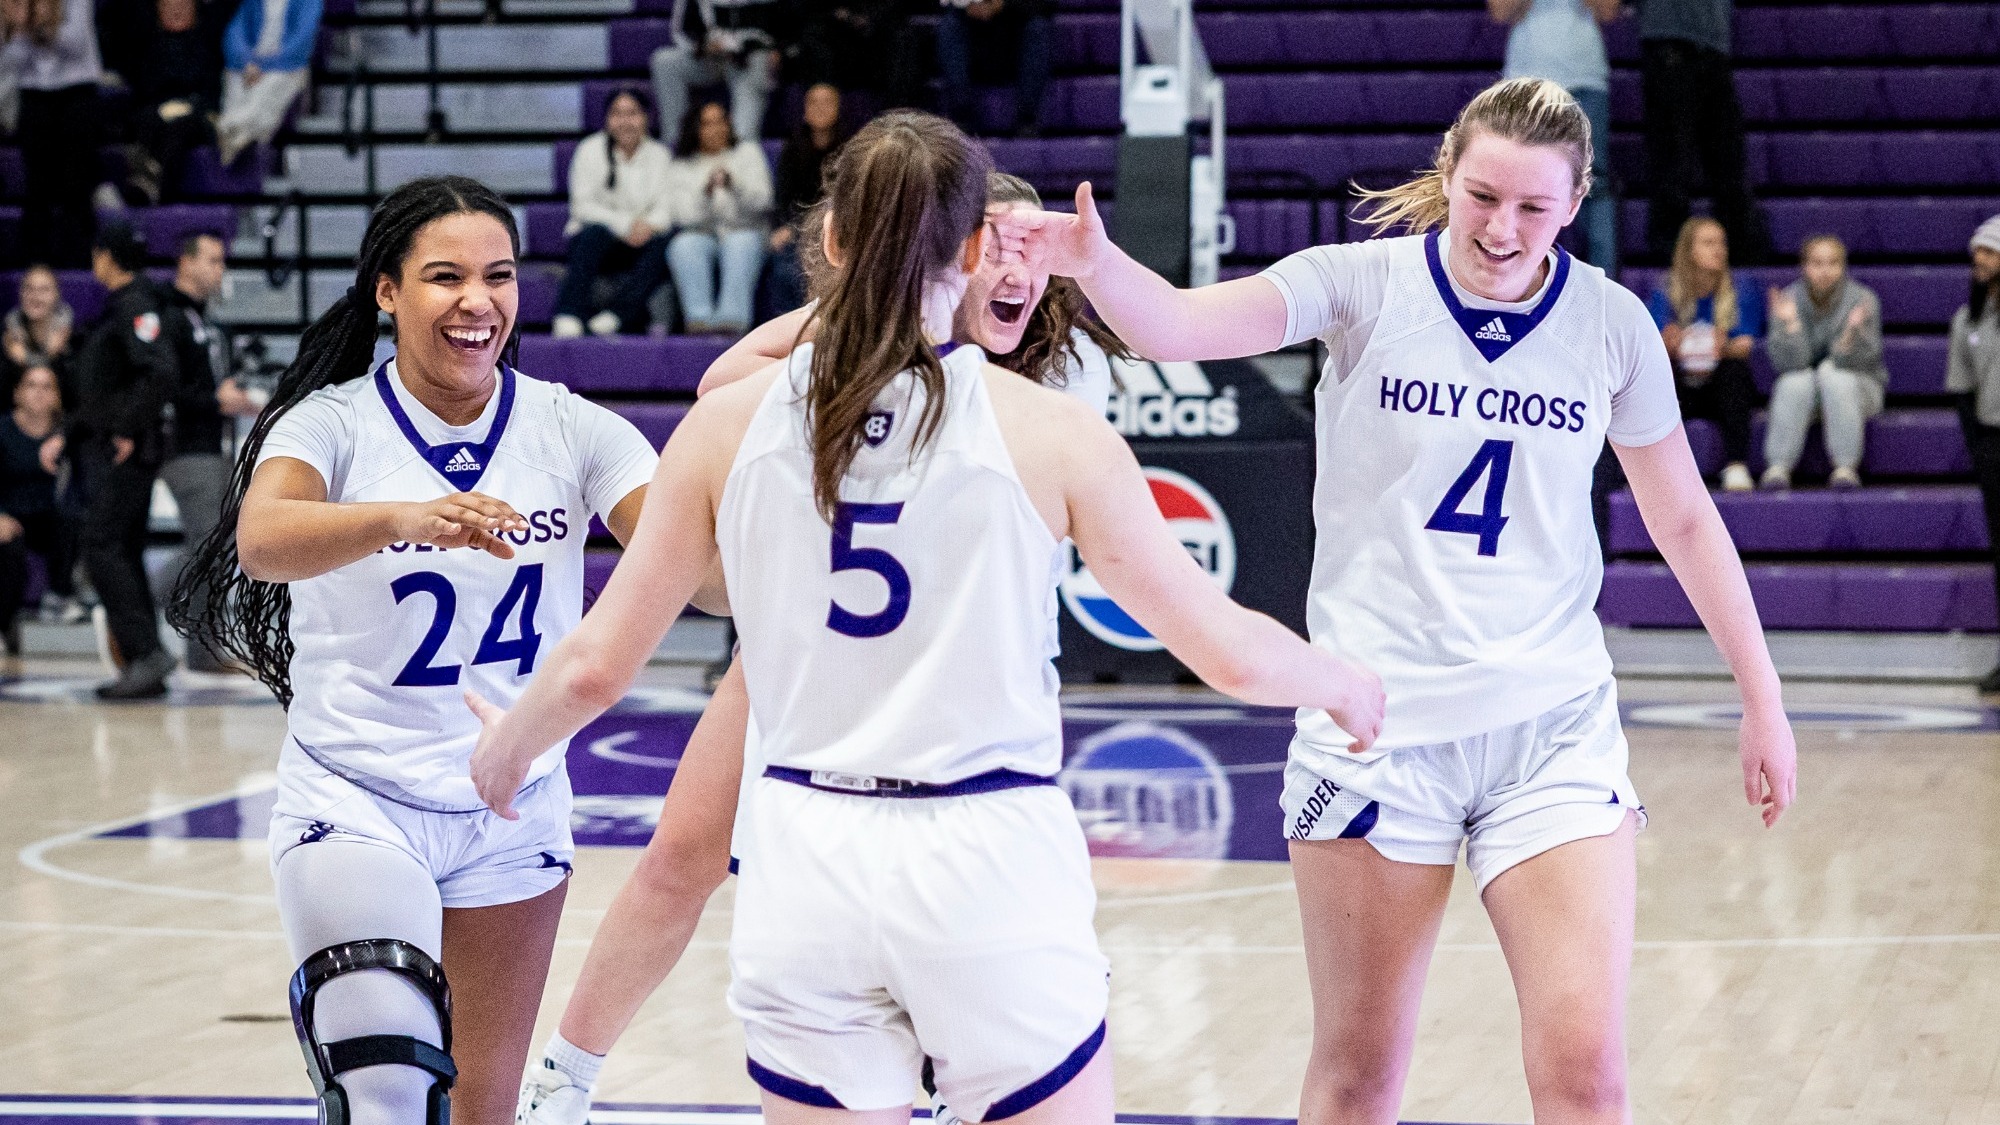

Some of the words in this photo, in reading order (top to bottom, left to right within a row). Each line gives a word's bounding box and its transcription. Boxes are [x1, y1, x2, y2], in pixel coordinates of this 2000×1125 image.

[1475, 329, 1512, 342] adidas
[1104, 392, 1240, 437] didas
[1379, 375, 1468, 418] HOLY
[1476, 387, 1587, 433] CROSS
[445, 461, 481, 473] adidas
[1424, 438, 1514, 557] 4
[825, 501, 912, 638] 5
[389, 562, 544, 687] 24
